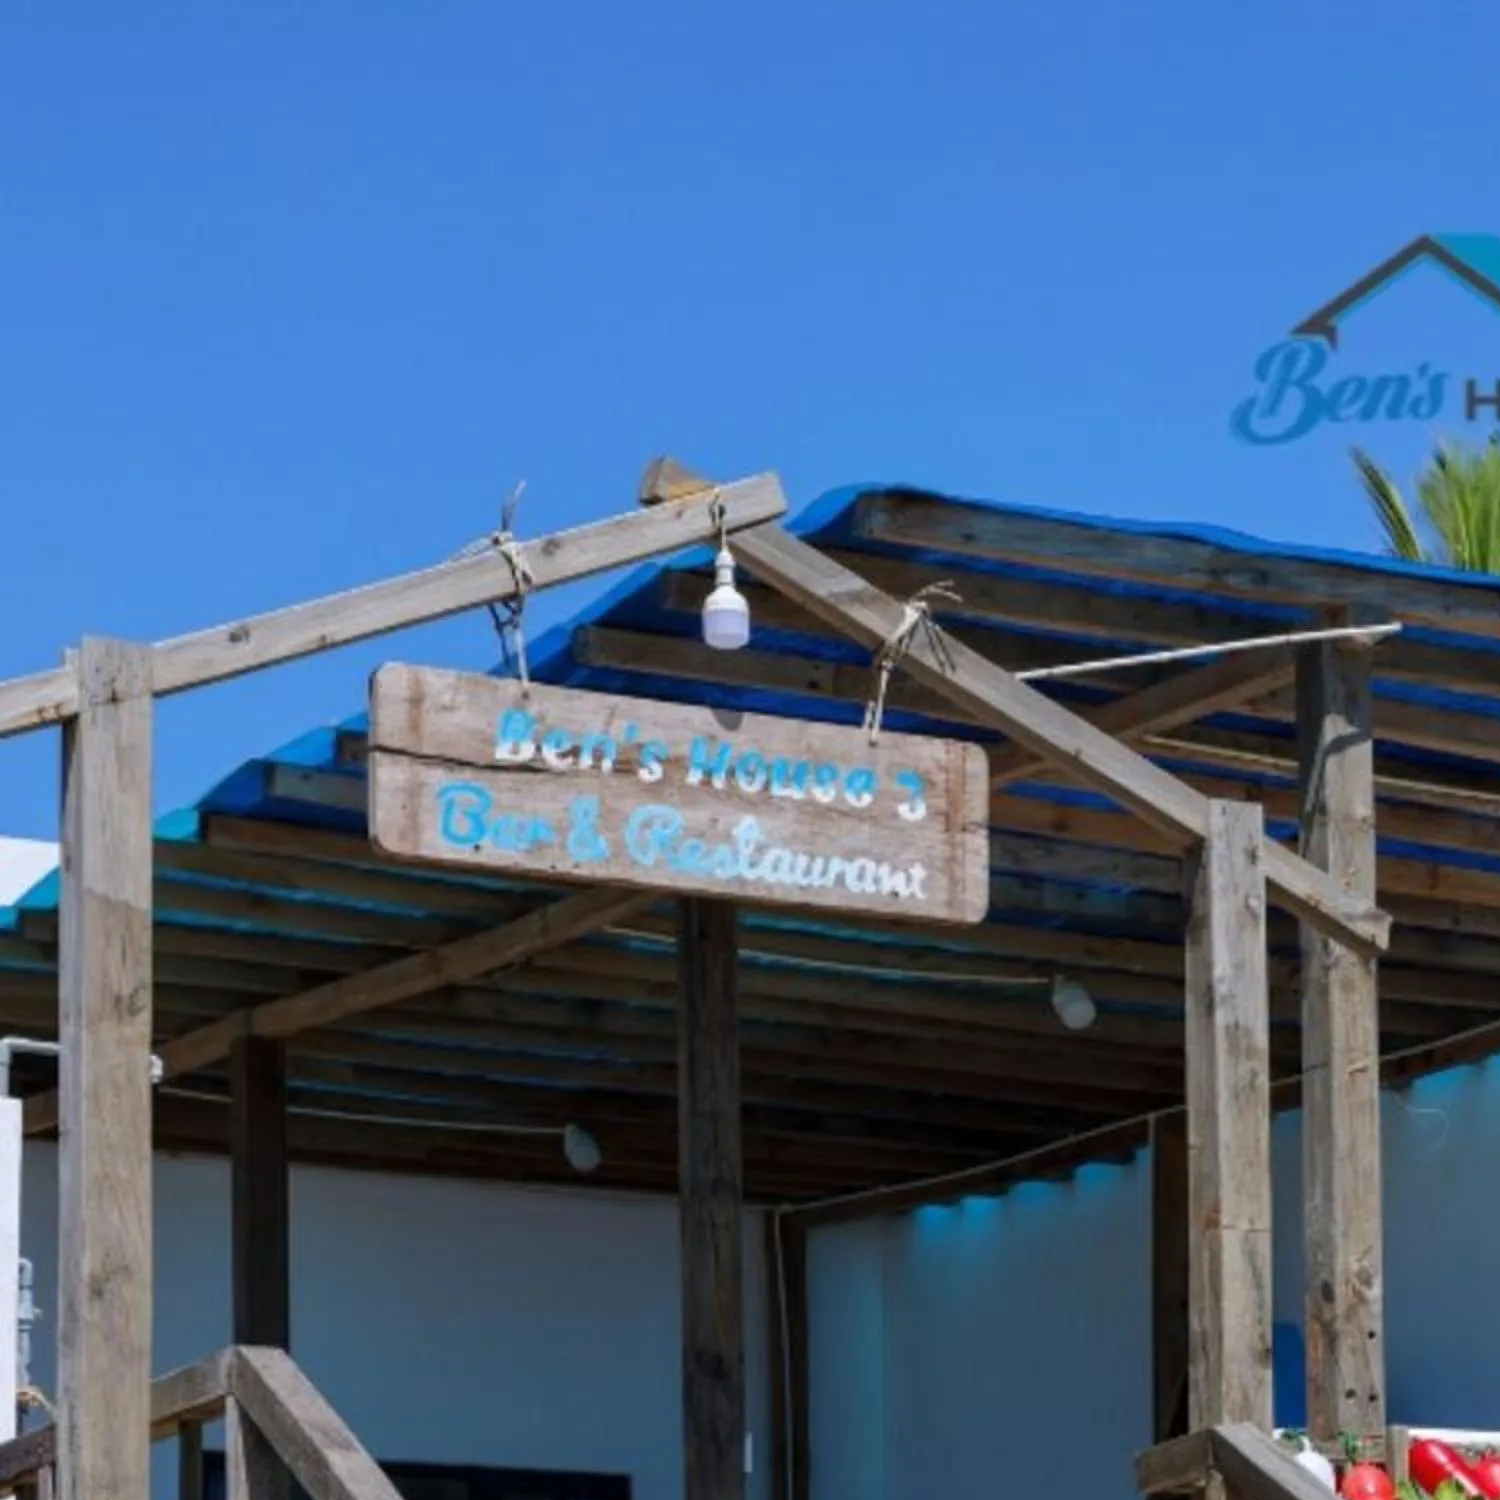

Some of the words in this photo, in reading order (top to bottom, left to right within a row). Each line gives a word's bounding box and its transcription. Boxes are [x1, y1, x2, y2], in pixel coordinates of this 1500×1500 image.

[495, 707, 667, 784] Ben's
[687, 735, 876, 808] House
[436, 778, 556, 853] Bar
[567, 794, 609, 862] &
[624, 803, 928, 900] Restaurant
